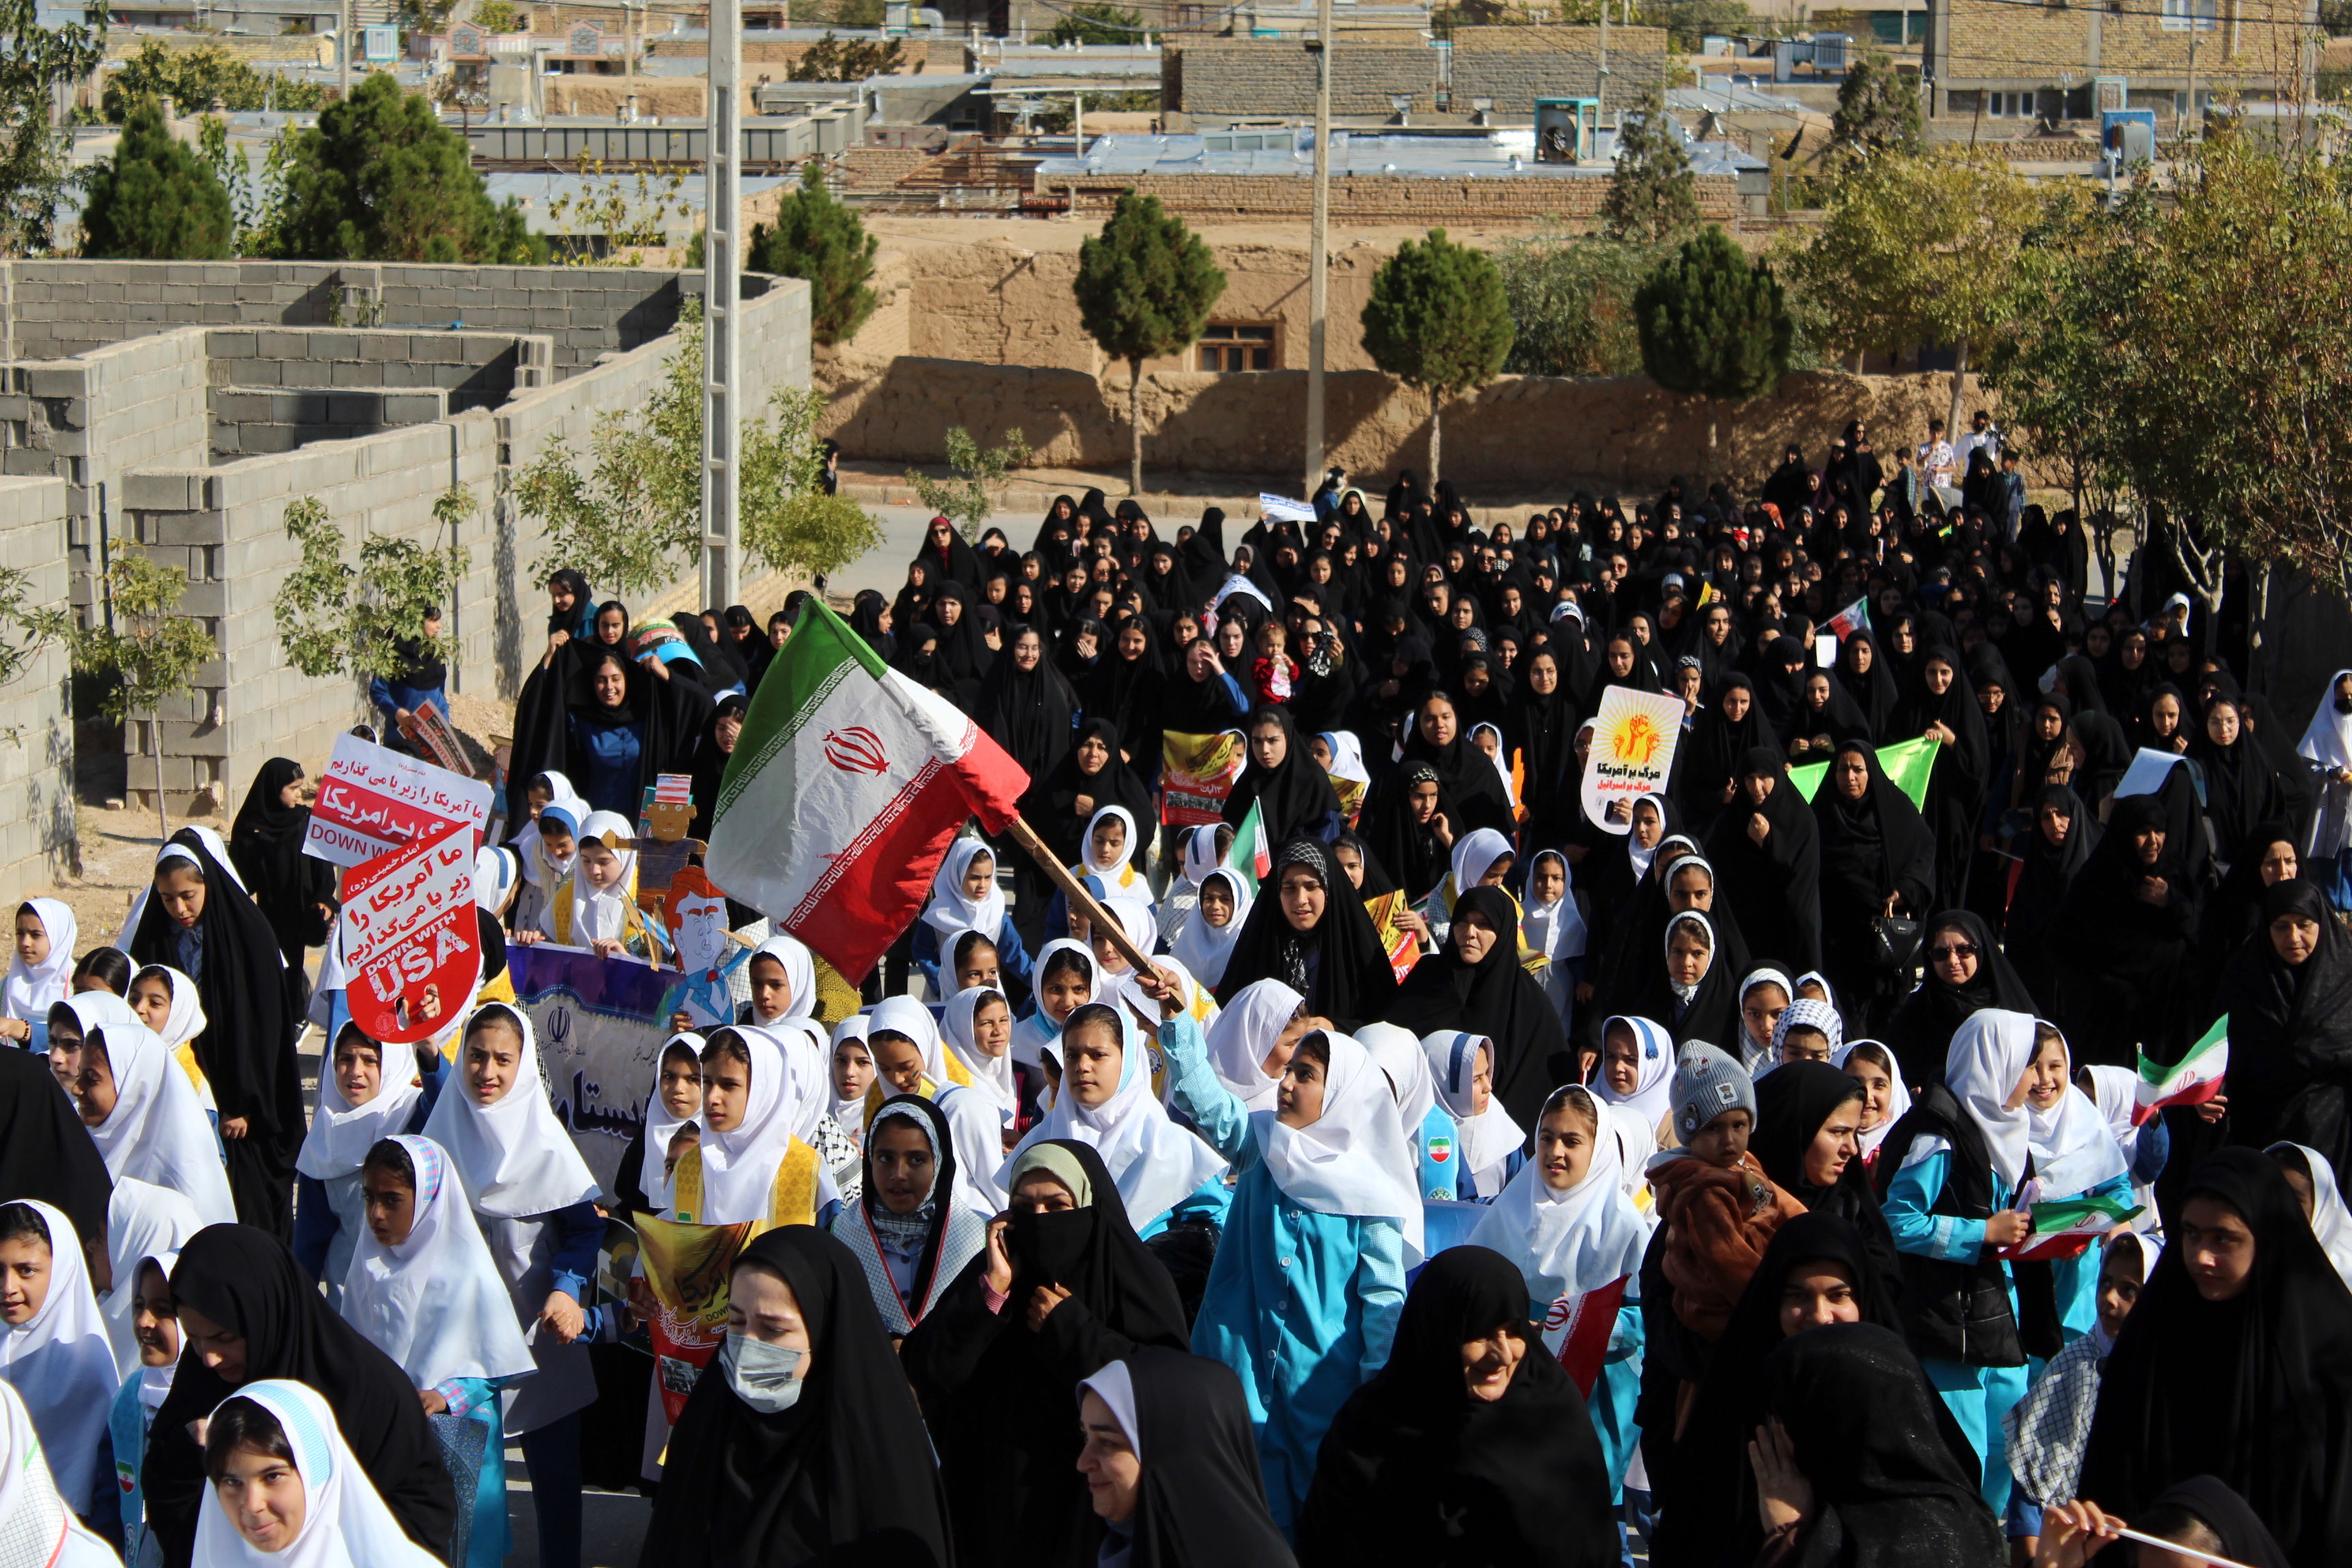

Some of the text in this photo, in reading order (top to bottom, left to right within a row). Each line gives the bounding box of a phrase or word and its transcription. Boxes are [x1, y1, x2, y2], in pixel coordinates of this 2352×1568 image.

[1629, 766, 1637, 779] بر
[398, 783, 417, 800] زیر
[421, 786, 431, 805] را
[434, 790, 472, 815] آمریکا
[472, 804, 483, 819] ما
[310, 823, 368, 856] DOWN
[400, 843, 421, 864] امام
[369, 858, 399, 884] خمینی
[348, 848, 463, 933] ما آمریکا را
[448, 872, 471, 901] زیر
[426, 891, 442, 911] پا
[366, 911, 457, 978] DOWN WITH
[368, 926, 471, 1003] USA
